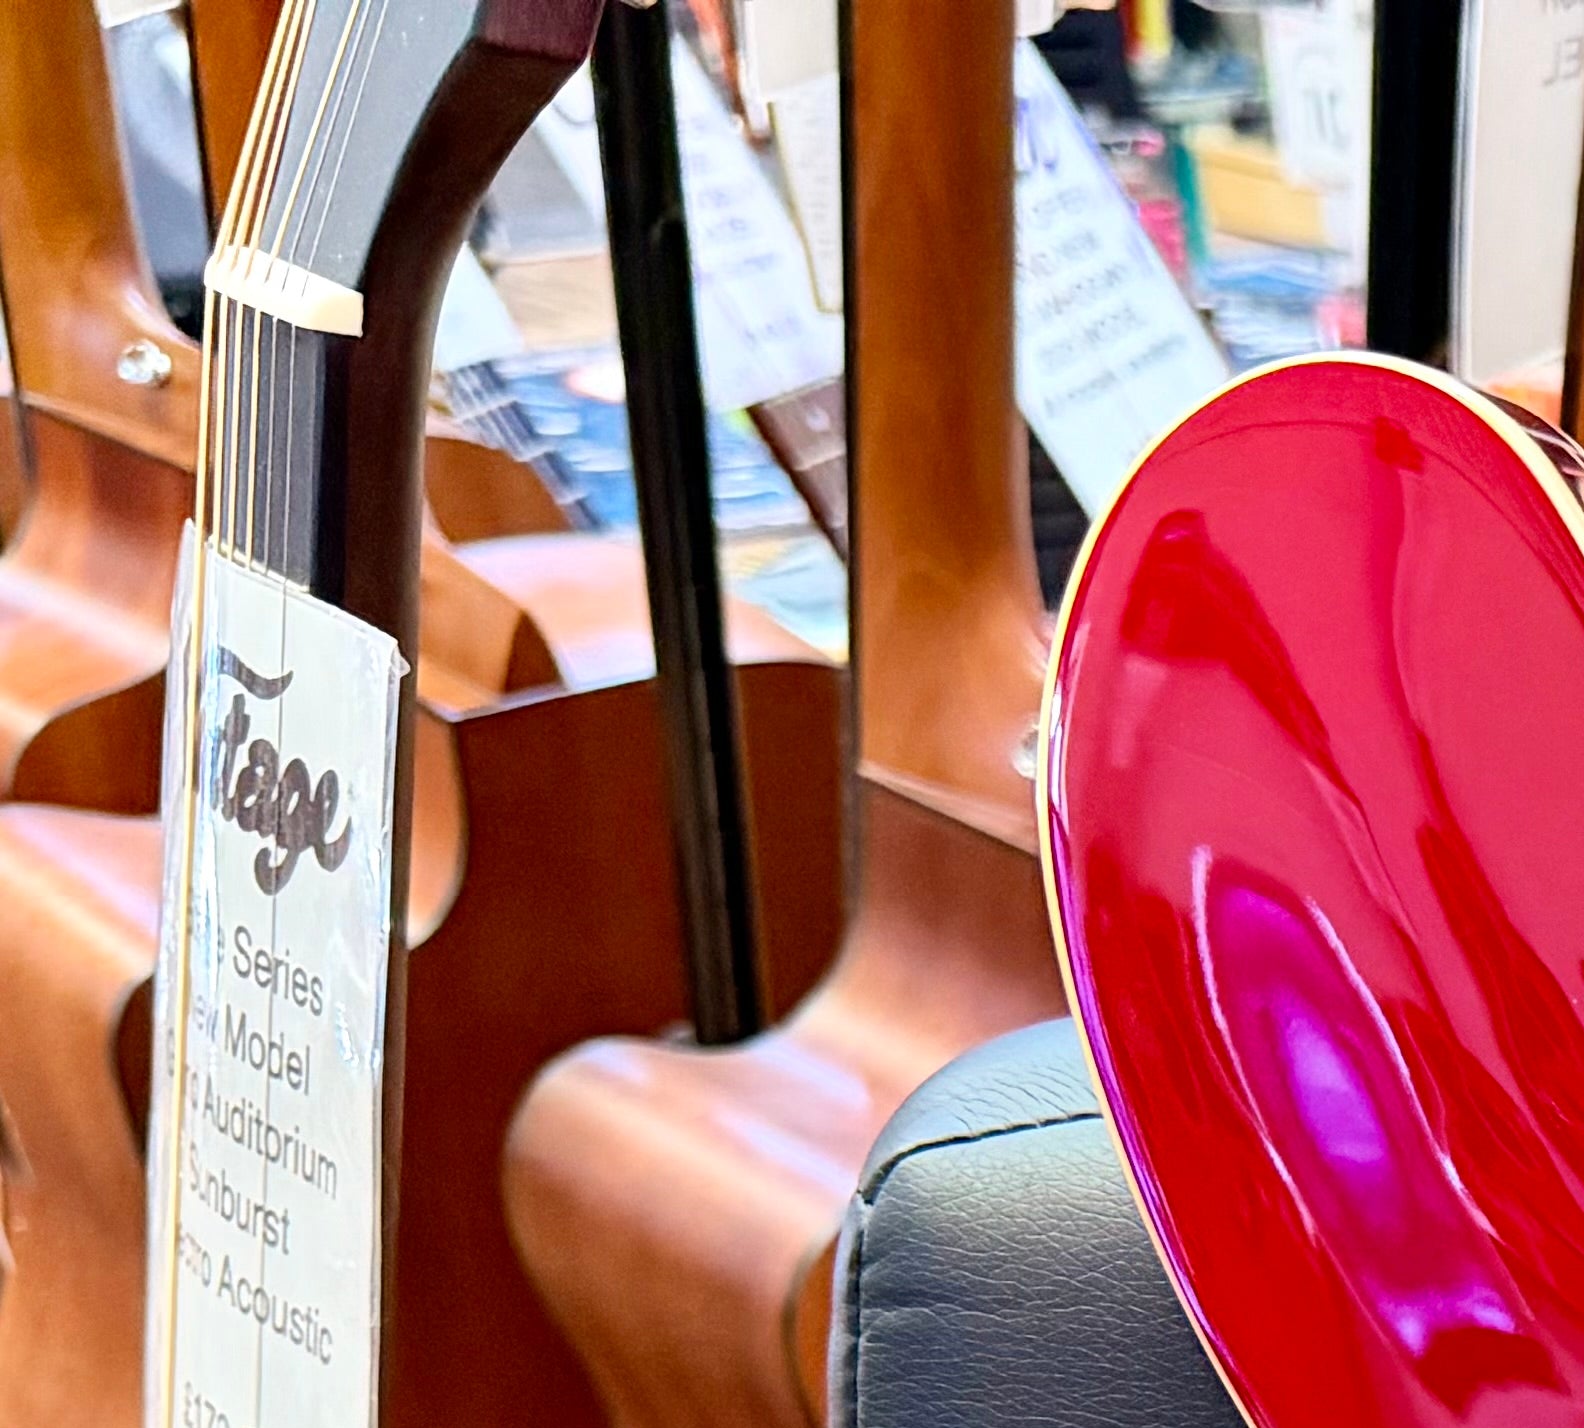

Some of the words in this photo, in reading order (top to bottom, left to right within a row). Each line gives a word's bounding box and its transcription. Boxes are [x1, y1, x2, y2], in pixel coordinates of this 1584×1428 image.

[233, 925, 323, 1017] Series
[224, 1002, 310, 1097] Model
[203, 1070, 338, 1201] Auditorium
[217, 1254, 333, 1365] Acoustic
